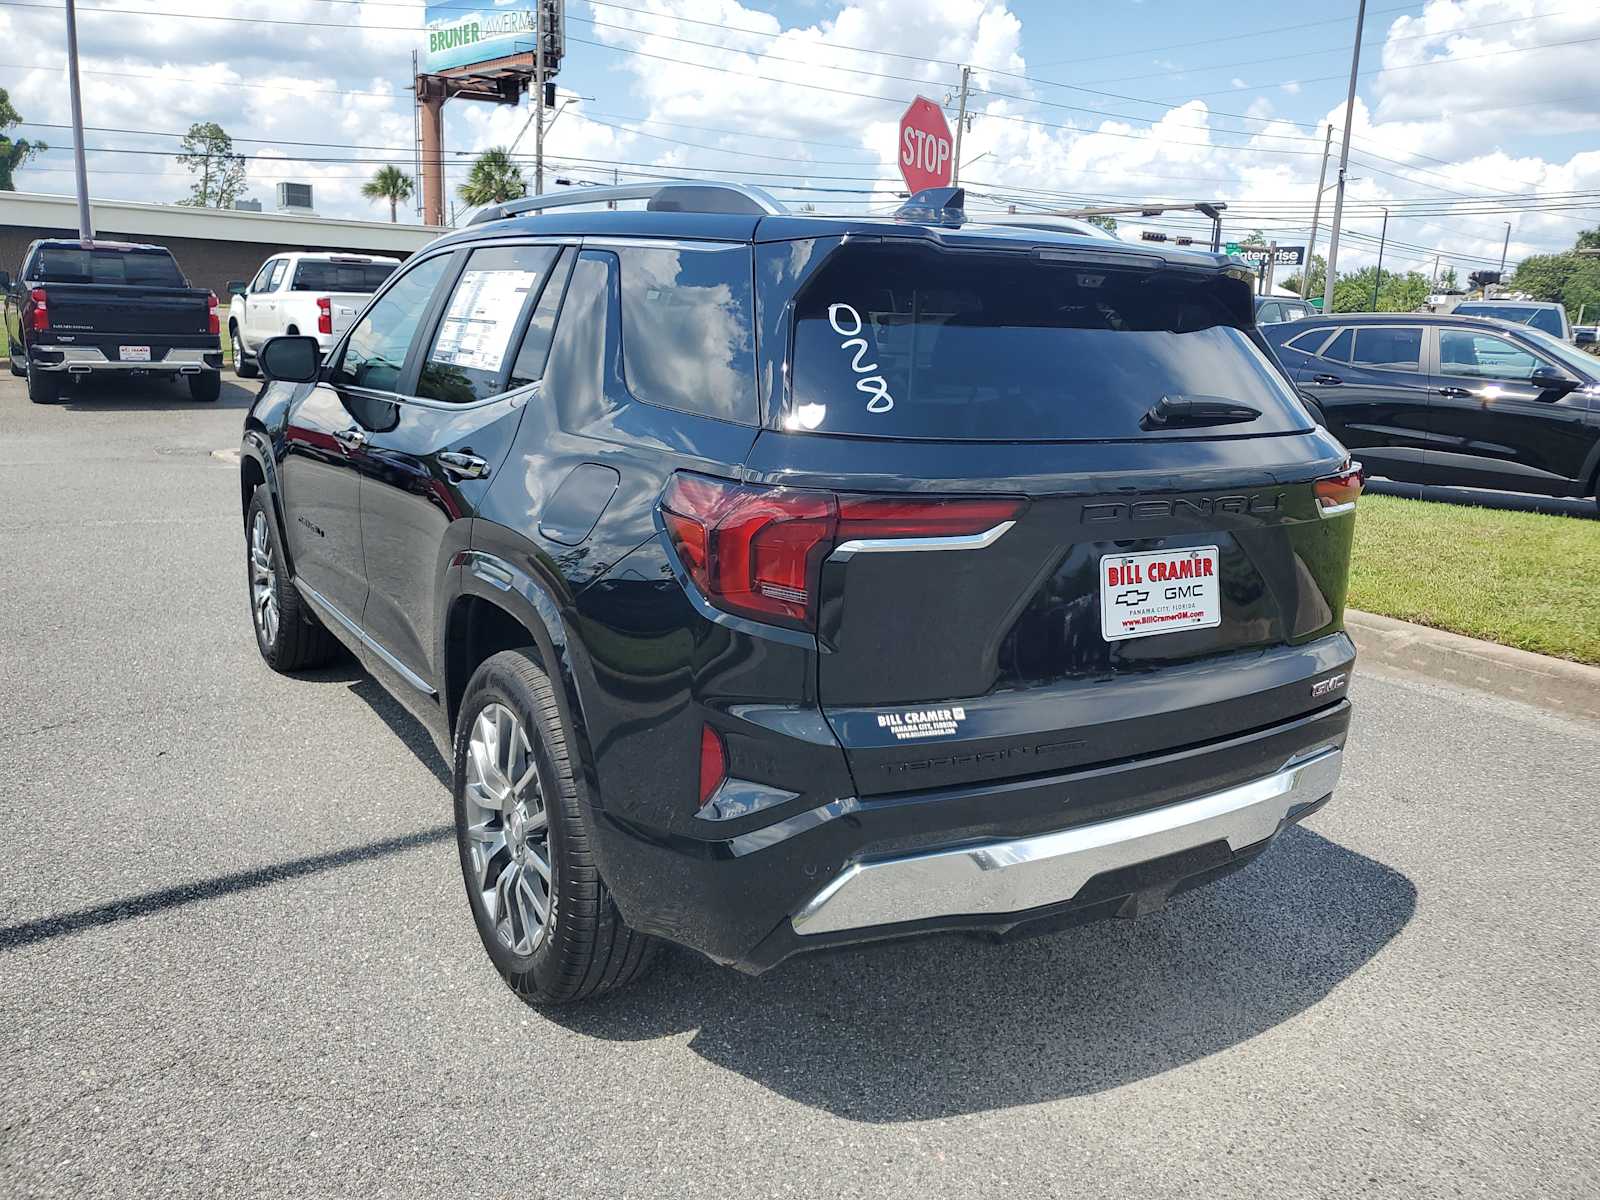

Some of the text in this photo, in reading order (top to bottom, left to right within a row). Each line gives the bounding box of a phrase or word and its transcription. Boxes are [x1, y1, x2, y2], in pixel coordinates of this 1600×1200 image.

[430, 22, 480, 53] BRUNER
[902, 126, 950, 176] STOP
[828, 303, 894, 413] 028
[1108, 558, 1214, 587] BILL CRAMER
[1164, 584, 1203, 600] GMC
[1121, 611, 1205, 627] www.BillCramerGM.com
[1129, 607, 1155, 616] PANAMA
[1173, 602, 1196, 610] FLORIDA
[1311, 673, 1345, 697] GMC
[877, 714, 903, 728] BILL
[904, 709, 953, 724] CRAMER
